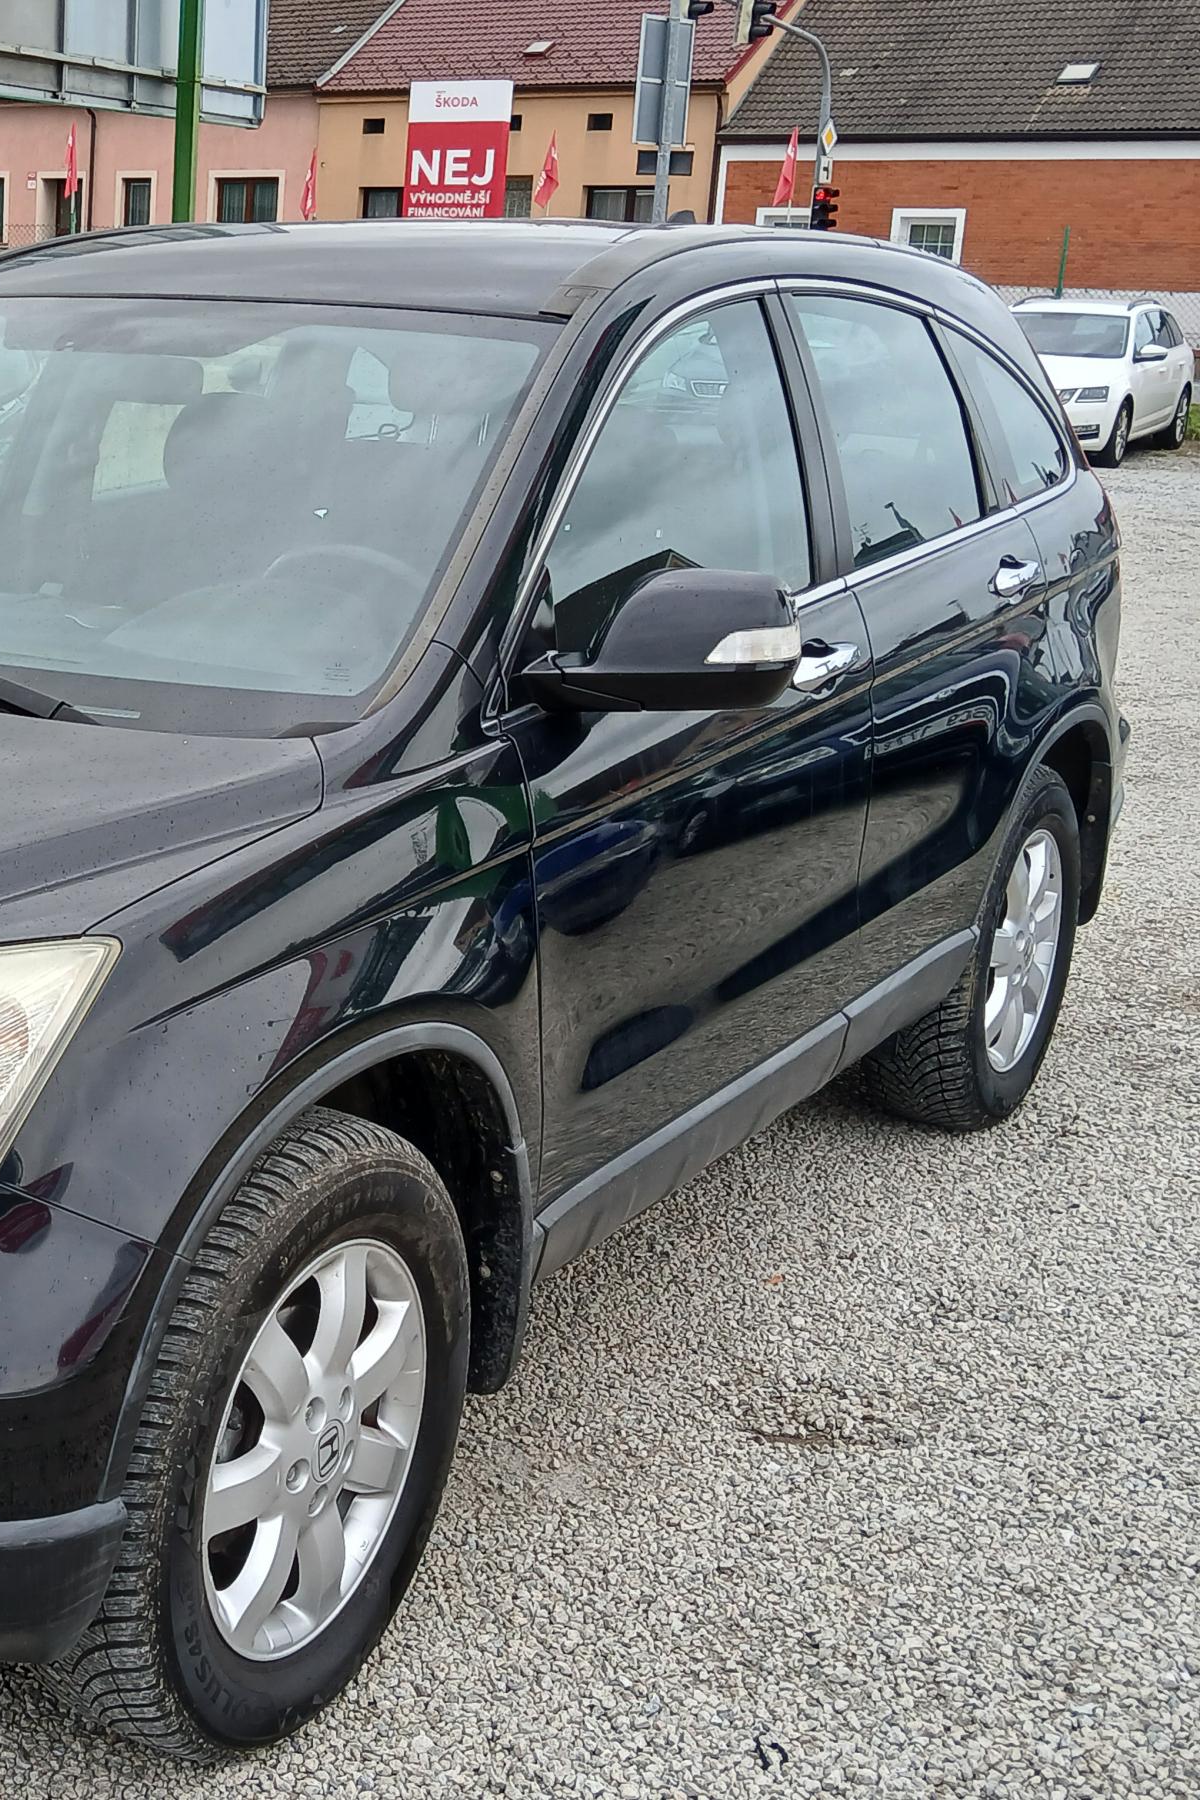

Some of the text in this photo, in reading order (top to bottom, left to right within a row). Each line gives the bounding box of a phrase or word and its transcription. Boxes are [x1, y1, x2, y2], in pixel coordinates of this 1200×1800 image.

[435, 94, 479, 108] ŠKODA
[410, 148, 496, 186] NEJ
[409, 189, 491, 205] VÝHODNĚJŠÍ
[407, 205, 485, 218] FINANCOVÁNÍ
